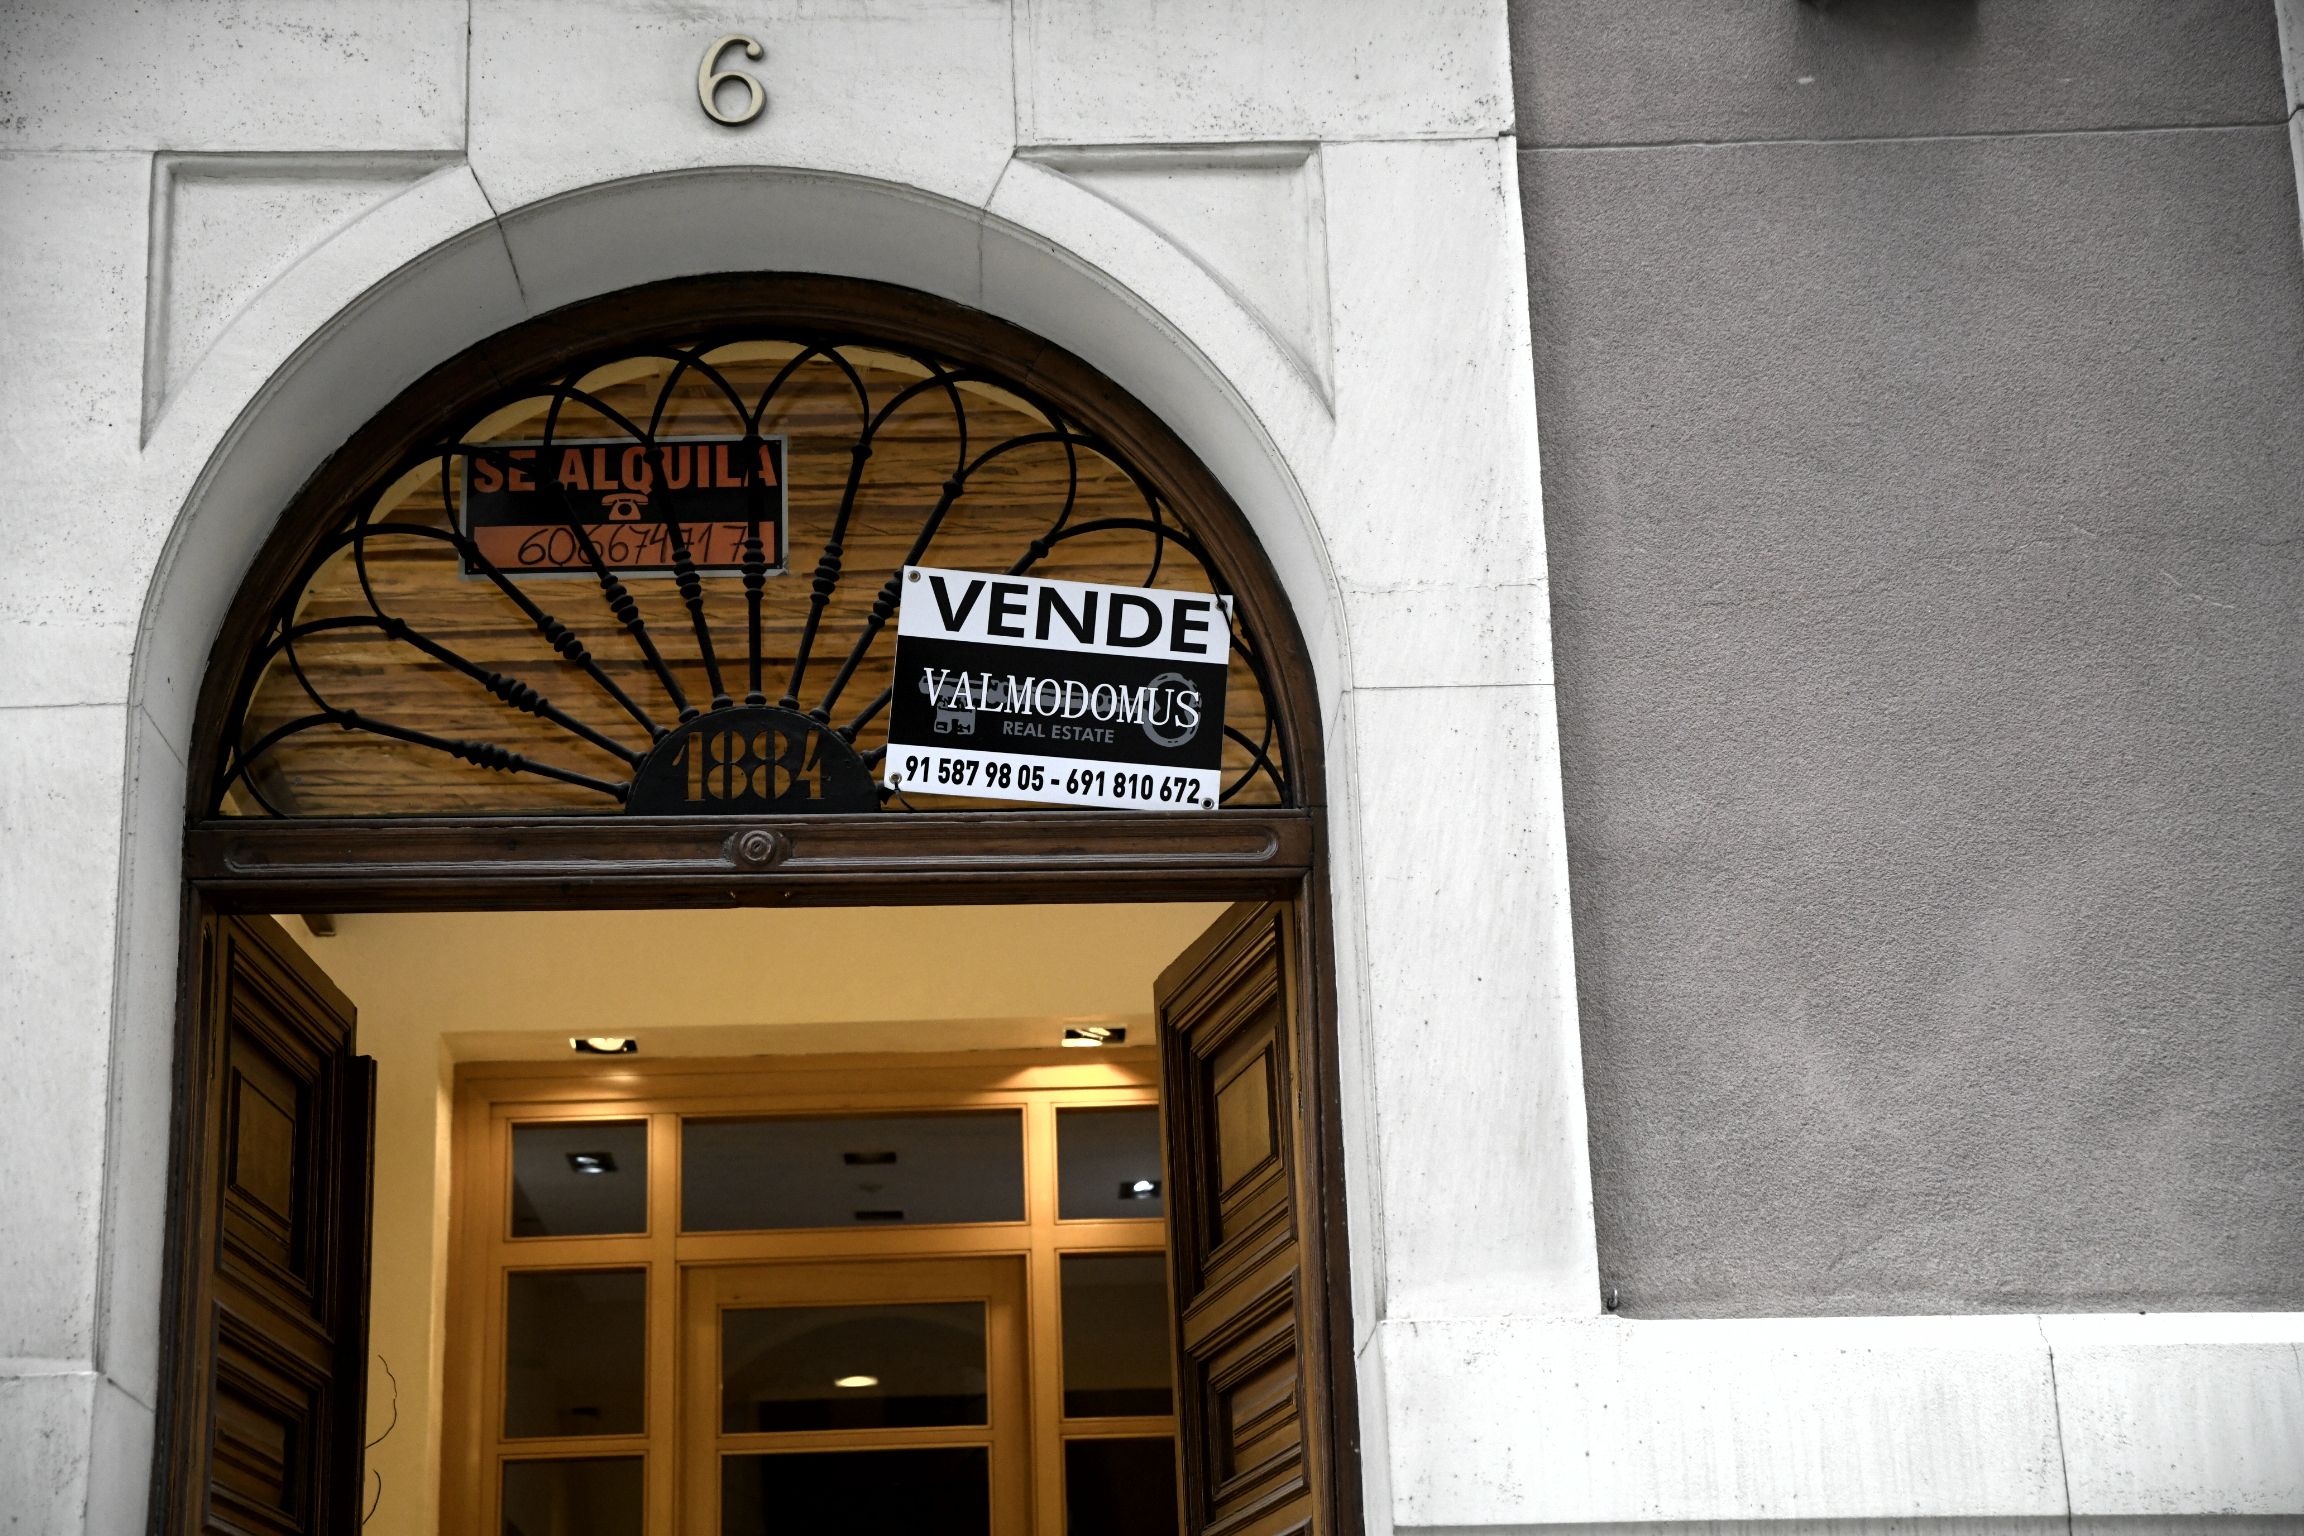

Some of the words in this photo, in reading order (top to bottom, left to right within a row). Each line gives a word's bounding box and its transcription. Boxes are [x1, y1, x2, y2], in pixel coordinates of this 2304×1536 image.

[697, 33, 767, 128] 6
[474, 449, 536, 494] SE
[557, 444, 778, 496] ALQUILA
[928, 575, 1211, 655] VENDE
[923, 667, 1201, 728] VALMODOMUS
[1002, 720, 1046, 738] REAL
[1051, 724, 1115, 744] ESTATE
[671, 729, 832, 802] 1884
[905, 755, 931, 783] 91
[937, 757, 980, 787] 587
[985, 761, 1012, 790] 98
[1017, 764, 1045, 792] 05
[1066, 768, 1106, 798] 691
[1113, 771, 1154, 801] 810
[1159, 776, 1201, 805] 672
